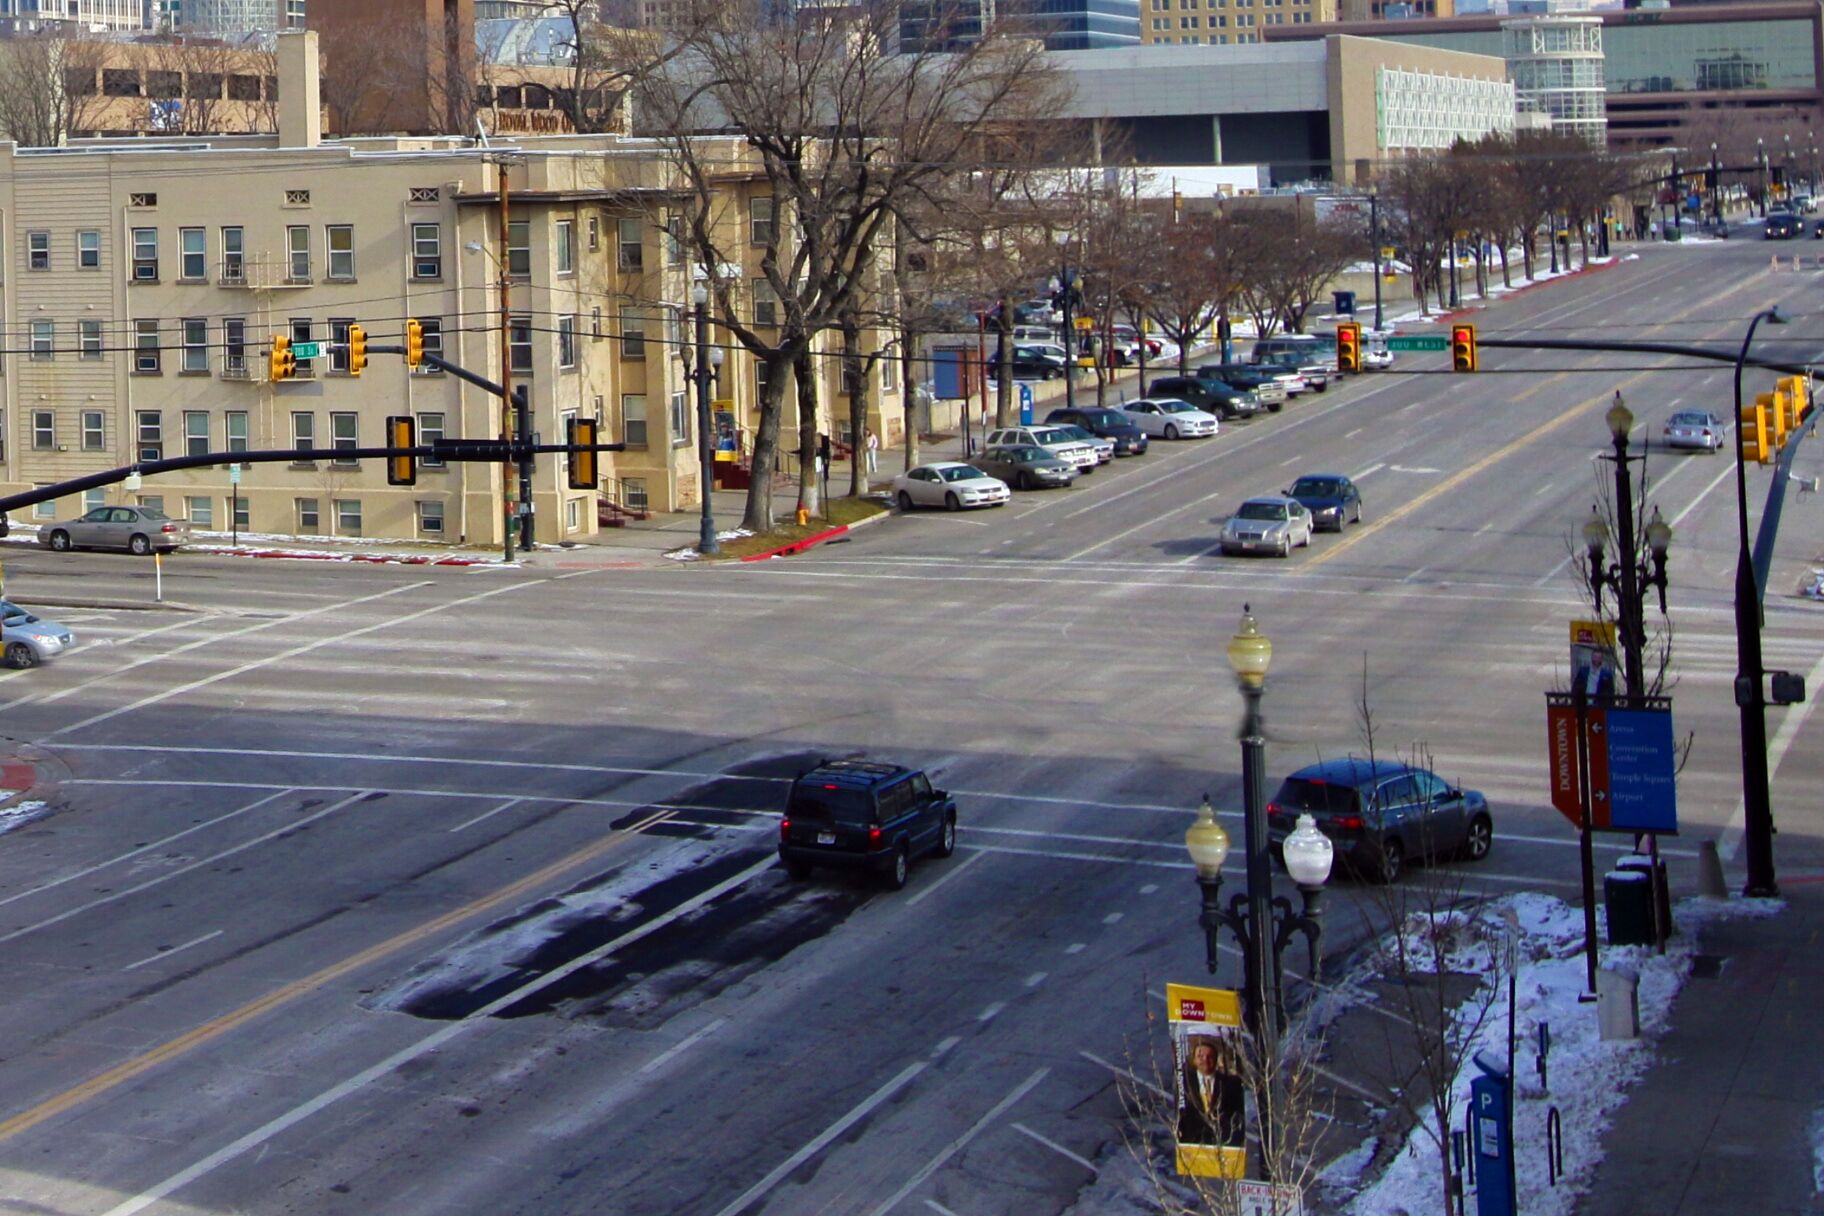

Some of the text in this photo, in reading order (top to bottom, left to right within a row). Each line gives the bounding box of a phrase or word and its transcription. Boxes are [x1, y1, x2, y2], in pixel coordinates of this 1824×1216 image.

[1556, 718, 1571, 792] DOWNTOWN
[1609, 745, 1658, 754] Convention
[1613, 791, 1644, 802] Airport
[1182, 1002, 1196, 1010] MY
[1174, 1007, 1233, 1021] DOWNTOWN
[1481, 1092, 1492, 1110] P
